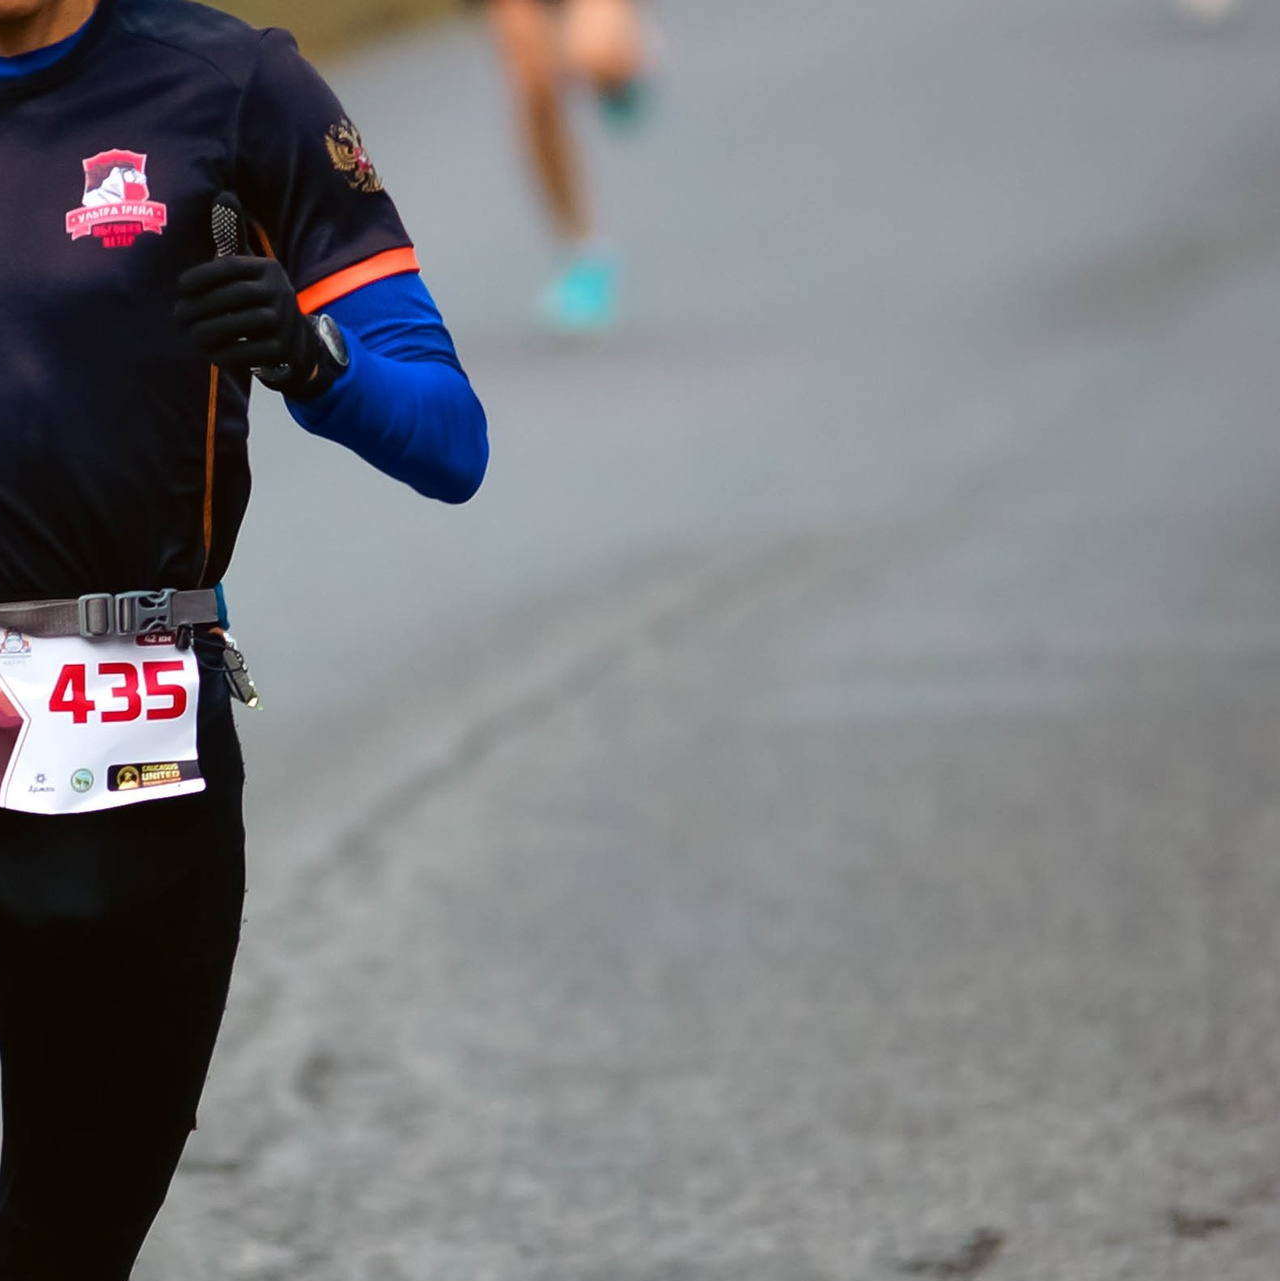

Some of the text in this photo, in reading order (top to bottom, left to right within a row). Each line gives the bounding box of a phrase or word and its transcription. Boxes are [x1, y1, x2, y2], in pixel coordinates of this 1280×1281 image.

[78, 205, 154, 223] УЛЬТРА ТРЕЙЛ
[48, 660, 187, 725] 435
[141, 770, 180, 781] UNITED
